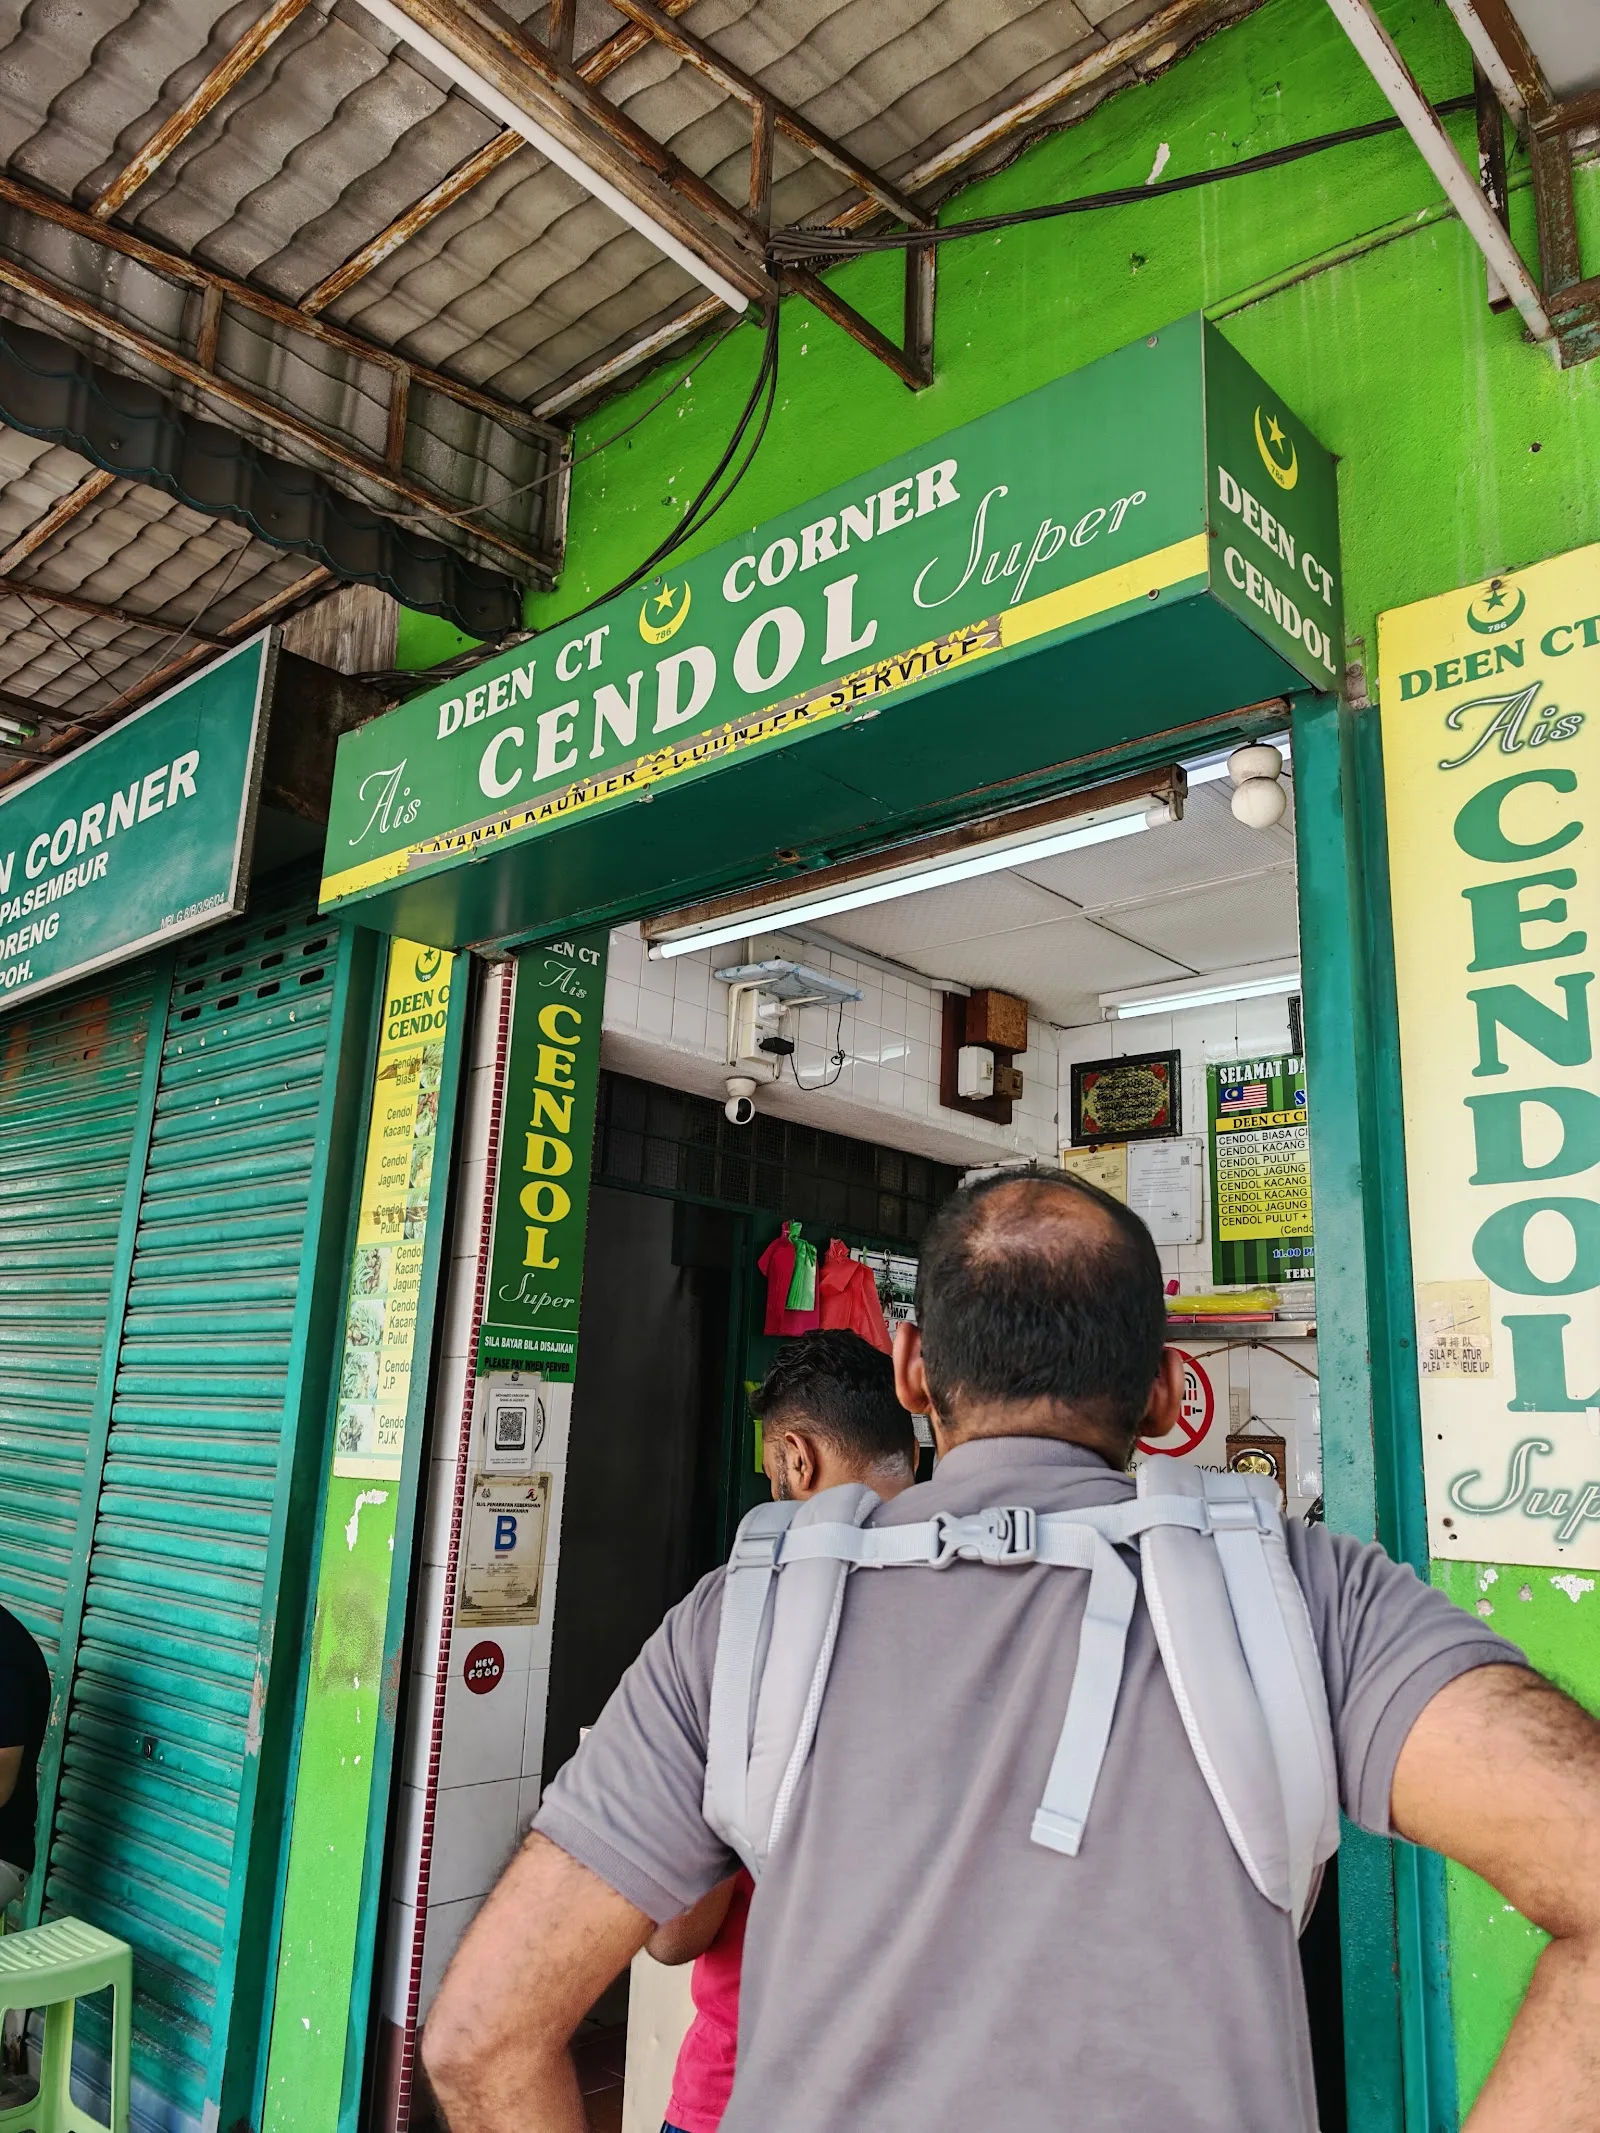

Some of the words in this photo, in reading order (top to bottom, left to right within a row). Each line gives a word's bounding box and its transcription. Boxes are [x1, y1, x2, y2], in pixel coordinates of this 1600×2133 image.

[1270, 464, 1285, 485] 786
[1218, 465, 1296, 570] DEEN
[1302, 552, 1334, 607] CT
[913, 485, 1147, 608] Super
[437, 661, 536, 740] DEEN
[556, 625, 610, 682] CT
[722, 458, 961, 602] CORNER
[1224, 546, 1337, 675] CENDOL
[655, 628, 672, 641] 786
[1487, 621, 1507, 633] 786
[1399, 638, 1525, 702] DEEN
[1540, 614, 1600, 657] CT
[478, 574, 878, 799] CENDOL
[1439, 680, 1584, 769] Ais
[349, 758, 421, 846] Ais
[25, 750, 200, 880] CORNER
[0, 851, 109, 928] PASEMBUR
[578, 947, 600, 966] CT
[538, 960, 587, 998] Ais
[389, 989, 434, 1018] DEEN
[393, 1054, 419, 1069] Cendol
[395, 1074, 417, 1086] Biasa
[1220, 1060, 1282, 1084] SELAMAT
[1453, 768, 1600, 1412] CENDOL
[386, 1104, 413, 1120] Cendol
[1233, 1115, 1268, 1129] DEEN
[1272, 1112, 1290, 1124] CT
[383, 1123, 411, 1138] Kacang
[520, 1004, 582, 1269] CENDOL
[1219, 1134, 1260, 1146] CENDOL
[1262, 1130, 1292, 1140] BIASA
[1294, 1128, 1308, 1140] (C
[1220, 1144, 1260, 1156] CENDOL
[1262, 1140, 1306, 1152] KACANG
[381, 1153, 408, 1168] Cendol
[1220, 1156, 1260, 1168] CENDOL
[1263, 1153, 1296, 1163] PULUT
[377, 1172, 406, 1188] Jagung
[1220, 1168, 1261, 1180] CENDOL
[1264, 1164, 1306, 1176] JAGUNG
[1220, 1180, 1262, 1192] CENDOL
[1264, 1176, 1306, 1188] KACANG
[1221, 1192, 1262, 1203] CENDOL
[1264, 1188, 1308, 1200] KACANG
[376, 1202, 403, 1217] Cendol
[1222, 1204, 1262, 1214] CENDOL
[1265, 1200, 1308, 1212] JAGUNG
[1222, 1216, 1262, 1226] CENDOL
[1266, 1212, 1298, 1223] PULUT
[381, 1222, 400, 1234] Pulut
[499, 1272, 575, 1314] Super
[891, 1308, 909, 1318] MAY
[388, 1332, 408, 1344] Pulut
[484, 1336, 500, 1347] SILA
[501, 1337, 522, 1349] BAYAR
[524, 1340, 538, 1351] BILA
[540, 1341, 574, 1354] DISAJIKAN
[1437, 1336, 1474, 1348] 请排队
[1430, 1348, 1446, 1360] SILA
[484, 1356, 510, 1368] PLEASE
[512, 1358, 524, 1369] PAY
[546, 1361, 570, 1372] SERVED
[1480, 1362, 1490, 1373] UP
[383, 1376, 396, 1389] J.P
[494, 1516, 517, 1552] B
[476, 1657, 494, 1668] HEY
[468, 1664, 500, 1680] FOOD
